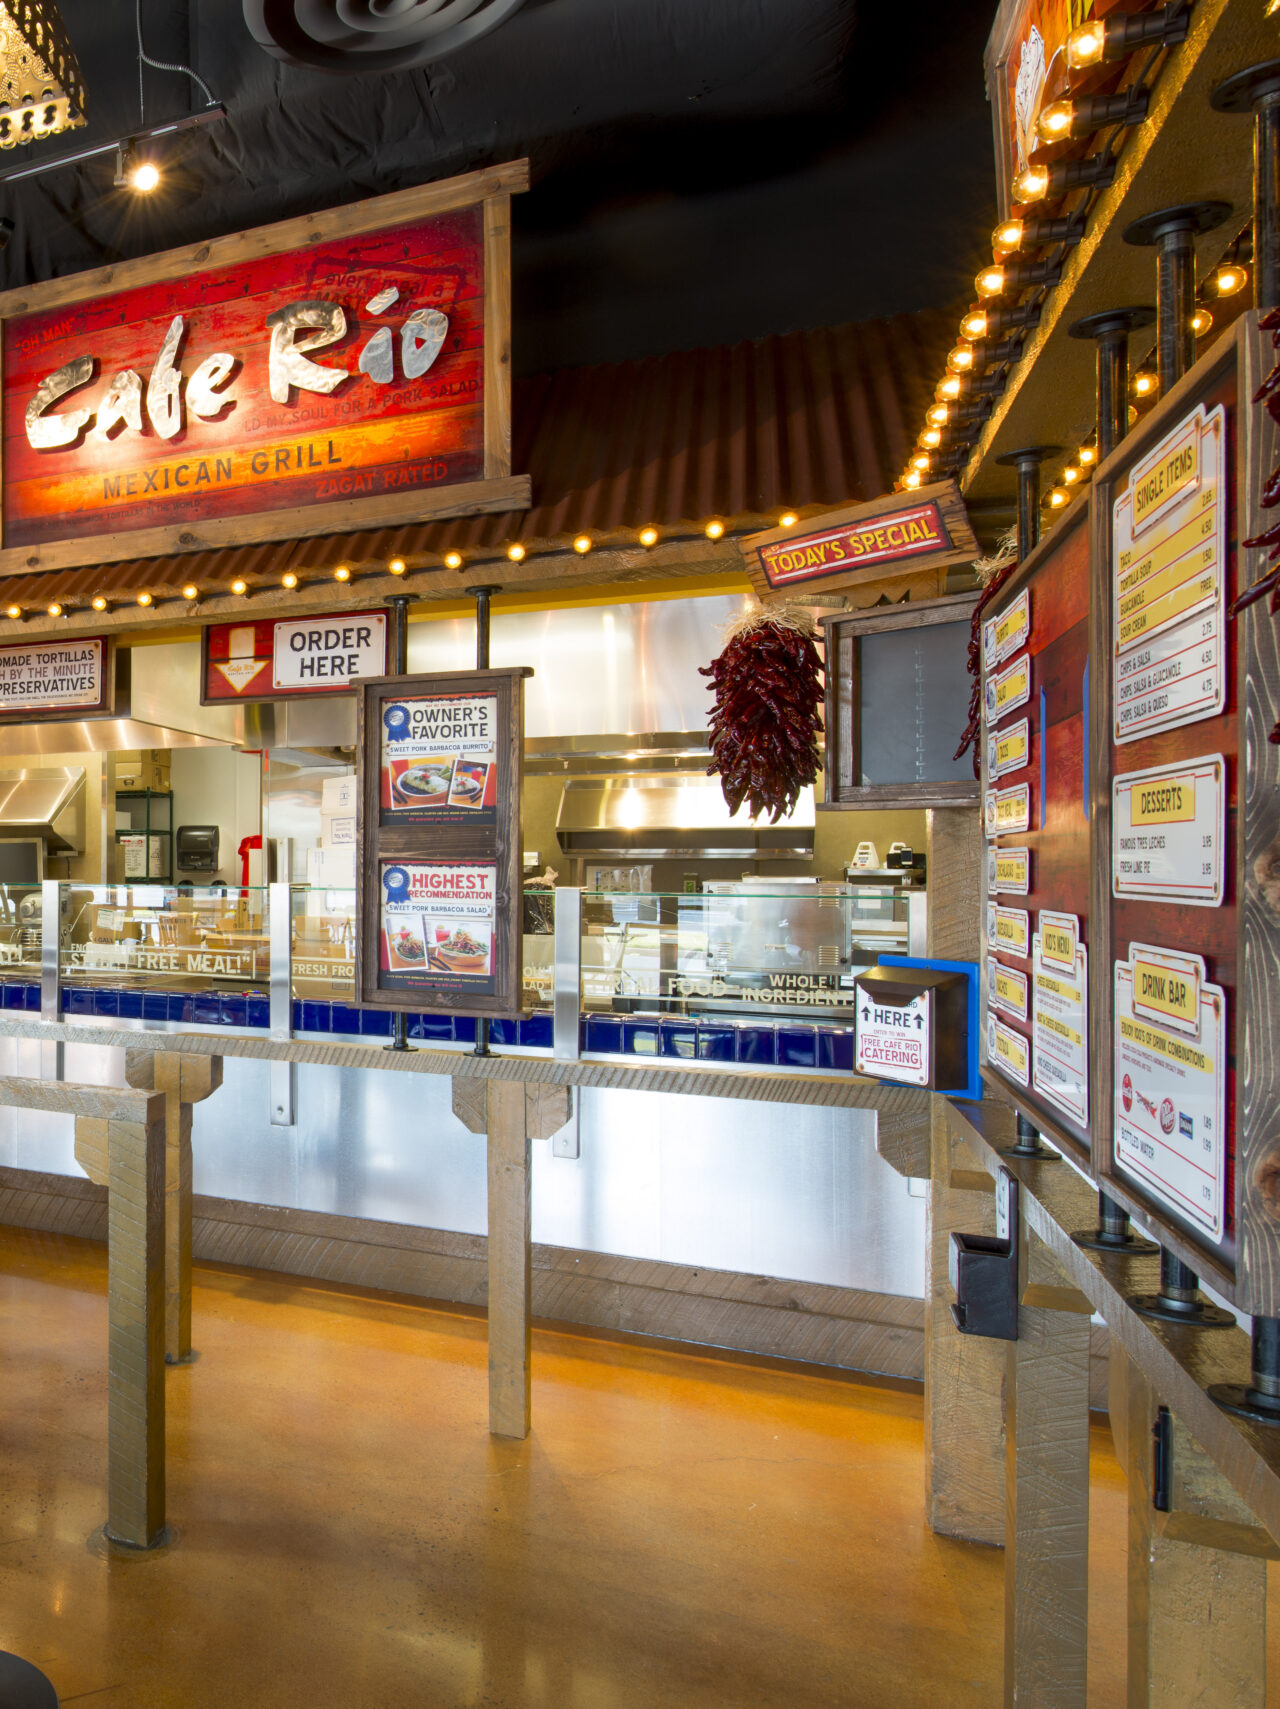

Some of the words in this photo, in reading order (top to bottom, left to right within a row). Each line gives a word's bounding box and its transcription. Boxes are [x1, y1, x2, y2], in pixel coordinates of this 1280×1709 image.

[266, 287, 449, 403] Rio
[333, 400, 361, 416] FOR
[367, 397, 377, 410] A
[382, 389, 422, 408] PORK
[104, 458, 232, 500] MEXICAN
[251, 440, 342, 475] GRILL
[316, 470, 375, 498] ZAGAT
[384, 462, 448, 489] RATED
[1137, 470, 1164, 513] SINGLE
[1166, 445, 1193, 487] ITEMS
[767, 541, 845, 574] TODAY'S
[849, 519, 938, 555] SPECIAL
[1120, 551, 1131, 569] TACO
[1120, 571, 1139, 592] TORTILLA
[1140, 560, 1152, 580] SOUP
[1120, 590, 1145, 616] GUACAMOLE
[1120, 624, 1131, 640] SOUR
[1132, 614, 1147, 633] CREAM
[1200, 576, 1212, 593] FREE
[289, 626, 371, 652] ORDER
[36, 649, 94, 664] TORTILLAS
[299, 654, 359, 678] HERE
[1120, 659, 1132, 676] CHIPS
[1138, 650, 1151, 668] SALSA
[10, 668, 23, 680] BY
[28, 666, 49, 678] THE
[53, 663, 95, 677] MINUTE
[1134, 677, 1147, 695] SALSA
[1152, 662, 1181, 686] GUACAMOLE
[412, 706, 488, 723] OWNER'S
[1134, 701, 1147, 717] SALSA
[1153, 694, 1168, 711] QUESO
[412, 723, 488, 740] FAVORITE
[1141, 786, 1182, 815] DESSERTS
[1120, 838, 1136, 850] FAMOUS
[1137, 837, 1148, 850] TRES
[1149, 836, 1166, 849] LECHES
[1120, 861, 1132, 873] FRESH
[412, 873, 488, 889] HIGHEST
[408, 890, 492, 899] RECOMMENDATION
[466, 906, 487, 914] SALAD
[1045, 933, 1056, 952] KID'S
[1057, 935, 1070, 956] MENU
[292, 963, 328, 975] FRESH
[668, 977, 730, 998] FOOD
[770, 974, 828, 989] WHOLE
[1142, 972, 1166, 1001] DRINK
[1169, 982, 1187, 1009] BAR
[742, 987, 854, 1007] INGREDIENT
[874, 1009, 911, 1028] HERE
[863, 1038, 881, 1047] FREE
[884, 1040, 902, 1049] CAFE
[905, 1042, 918, 1052] RIO
[864, 1047, 919, 1064] CATERING
[1121, 1021, 1134, 1037] ENJOY
[1146, 1031, 1152, 1043] OF
[1153, 1033, 1167, 1051] DRINK
[1168, 1041, 1206, 1069] COMBINATIONS
[1121, 1126, 1139, 1150] BOTTLED
[1140, 1141, 1154, 1160] WATER
